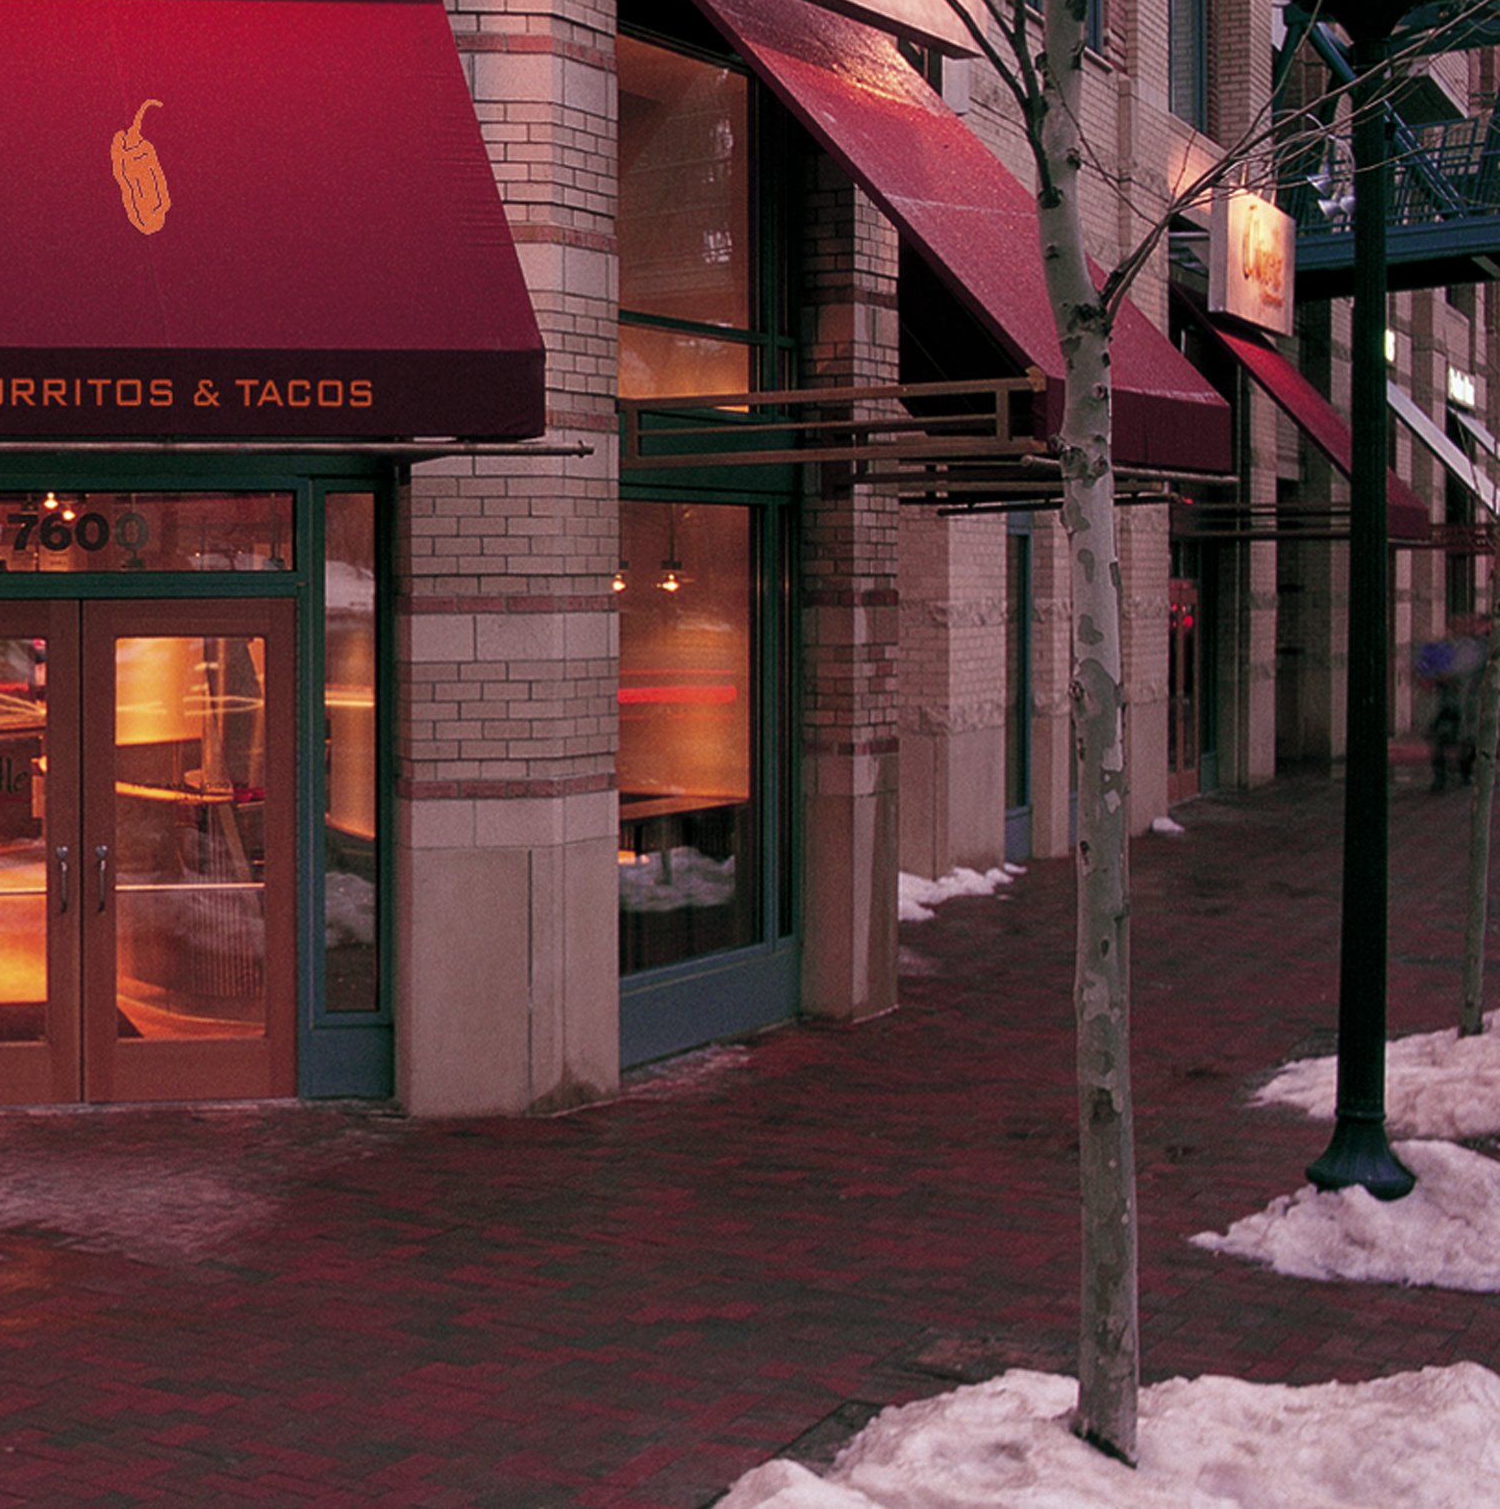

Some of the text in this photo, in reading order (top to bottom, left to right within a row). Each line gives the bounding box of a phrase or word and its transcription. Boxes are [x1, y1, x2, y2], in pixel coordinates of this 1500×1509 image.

[193, 380, 220, 407] &
[235, 379, 373, 407] TACOS
[7, 512, 149, 552] 7600
